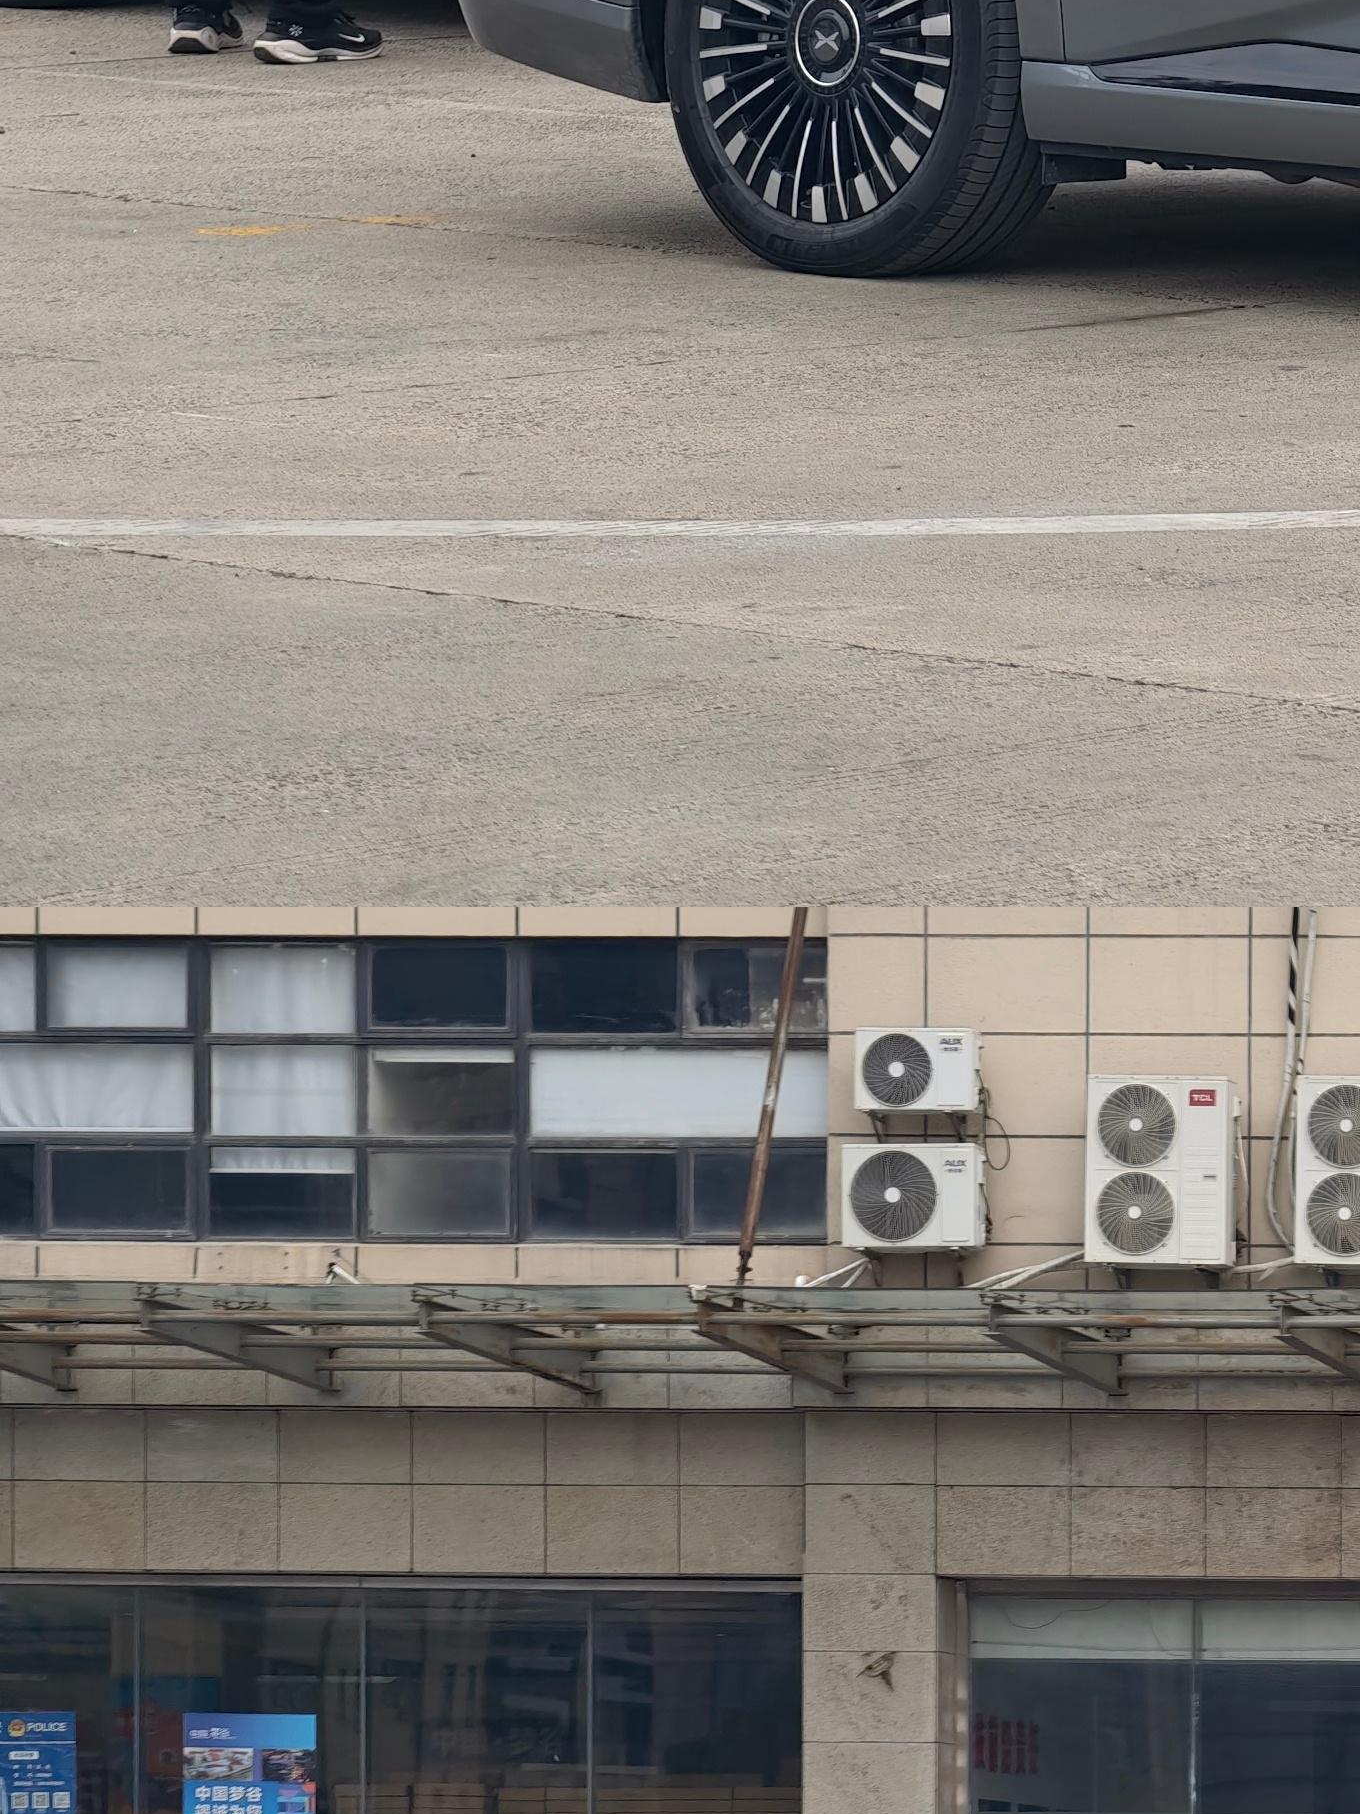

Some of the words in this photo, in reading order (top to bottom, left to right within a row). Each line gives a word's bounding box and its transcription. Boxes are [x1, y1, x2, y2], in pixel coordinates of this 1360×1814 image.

[1192, 1093, 1214, 1102] TCL
[26, 1722, 68, 1733] POLICE
[194, 1785, 263, 1803] 中国梦谷
